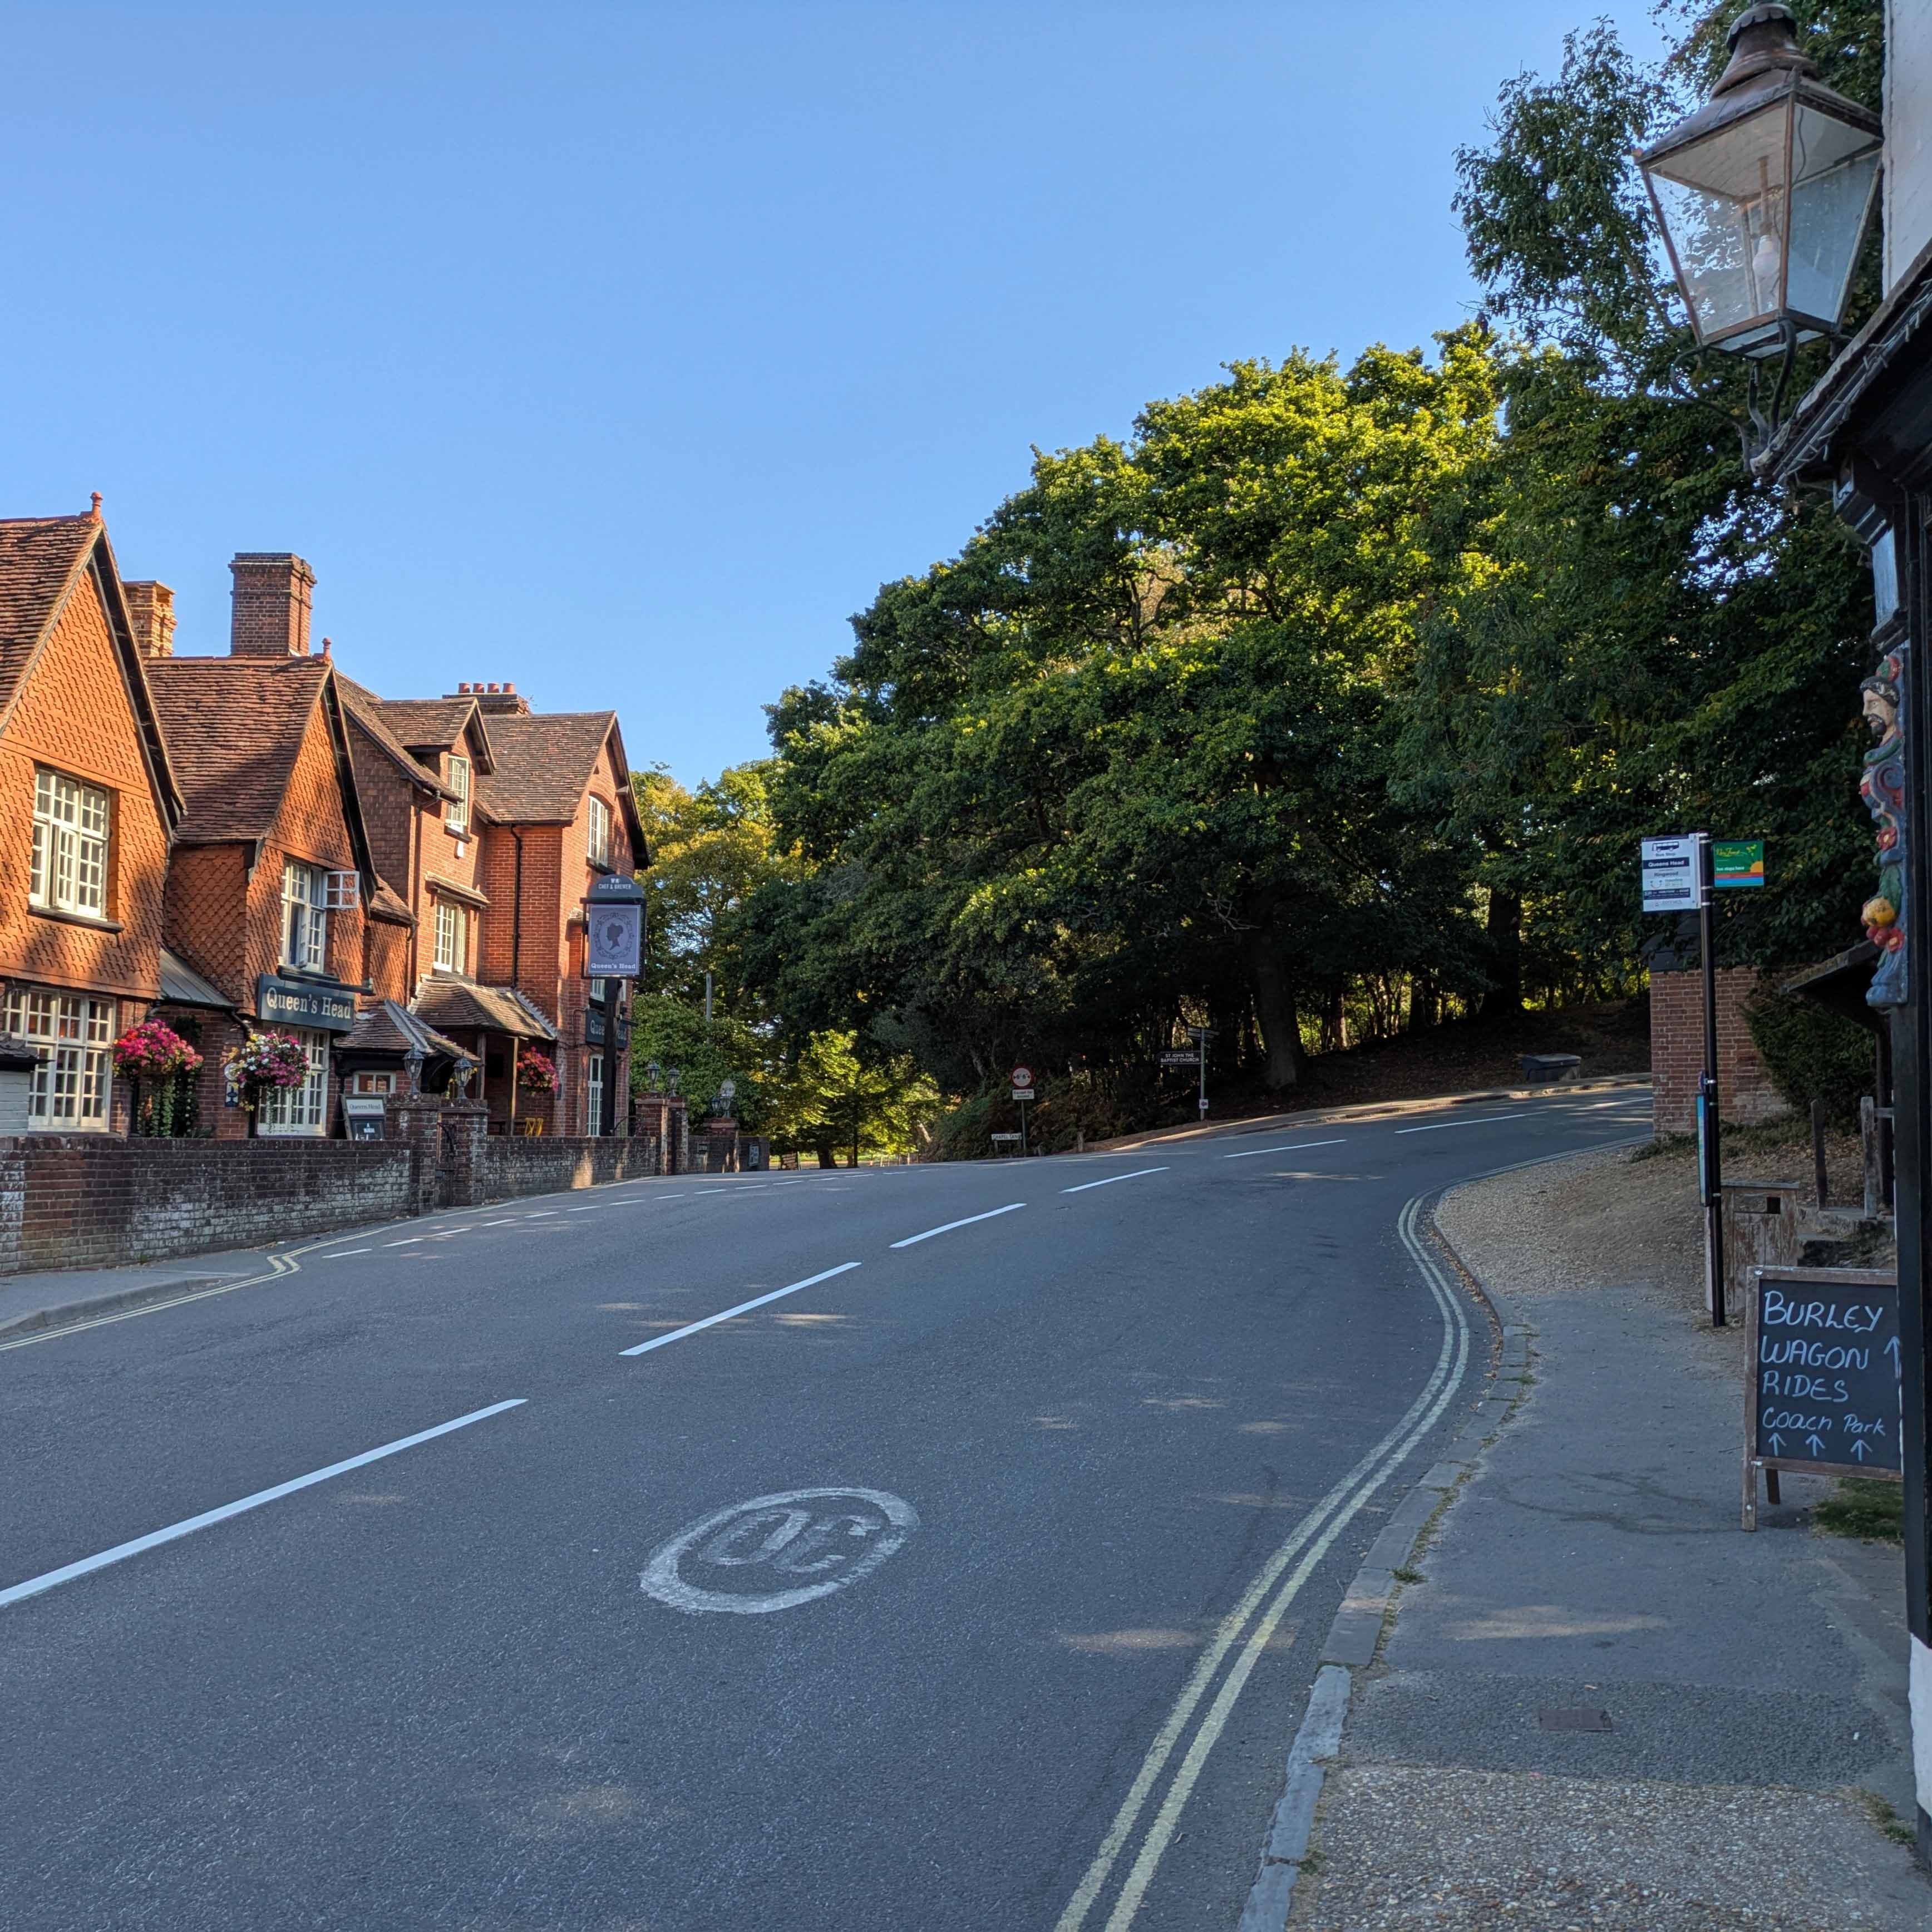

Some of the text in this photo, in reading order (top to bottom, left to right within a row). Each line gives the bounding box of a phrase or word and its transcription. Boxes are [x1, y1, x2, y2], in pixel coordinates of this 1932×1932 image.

[267, 987, 351, 1019] Queen's Head
[1764, 1290, 1884, 1333] BURLEY
[1761, 1335, 1869, 1370] WAGON
[1762, 1370, 1849, 1402] RIDES
[1844, 1413, 1886, 1437] Park
